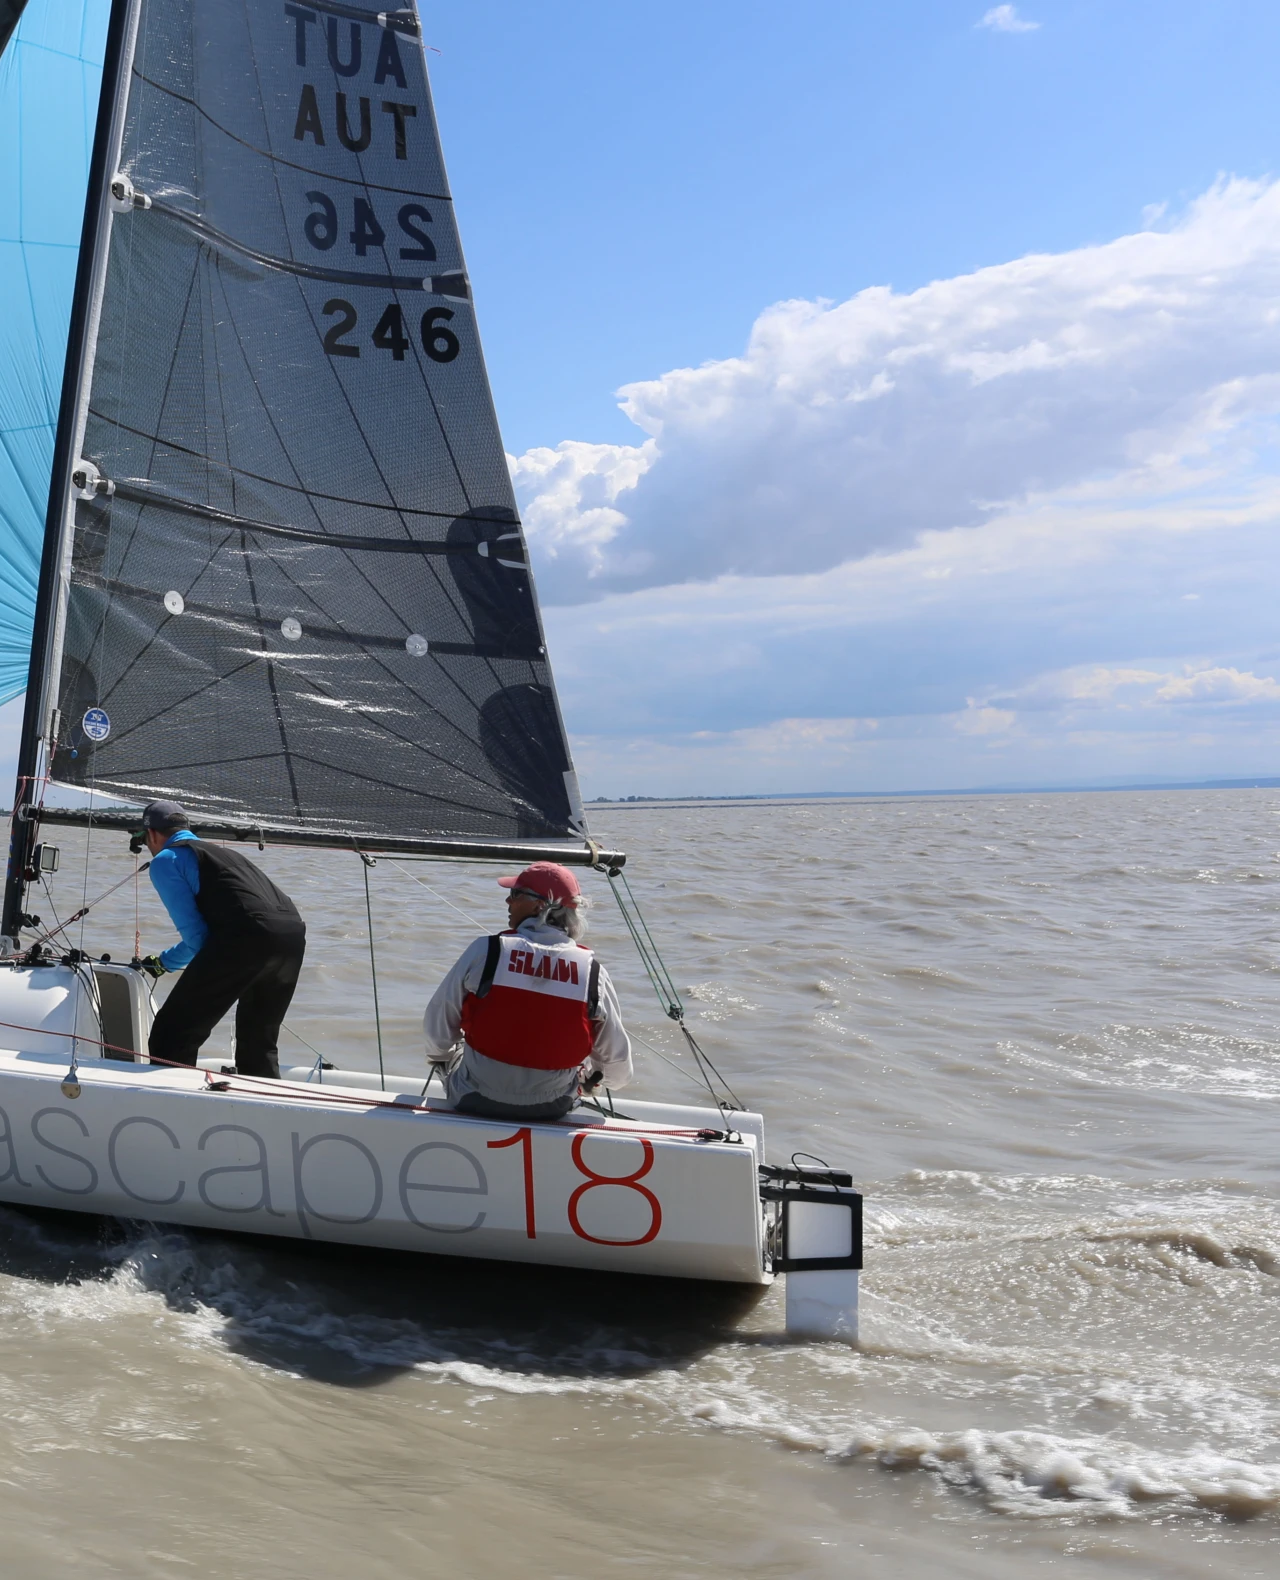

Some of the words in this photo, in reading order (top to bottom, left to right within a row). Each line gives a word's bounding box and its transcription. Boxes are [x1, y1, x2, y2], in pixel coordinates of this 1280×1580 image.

[294, 84, 417, 160] AUT
[322, 298, 460, 364] 246
[508, 949, 579, 986] SLAM
